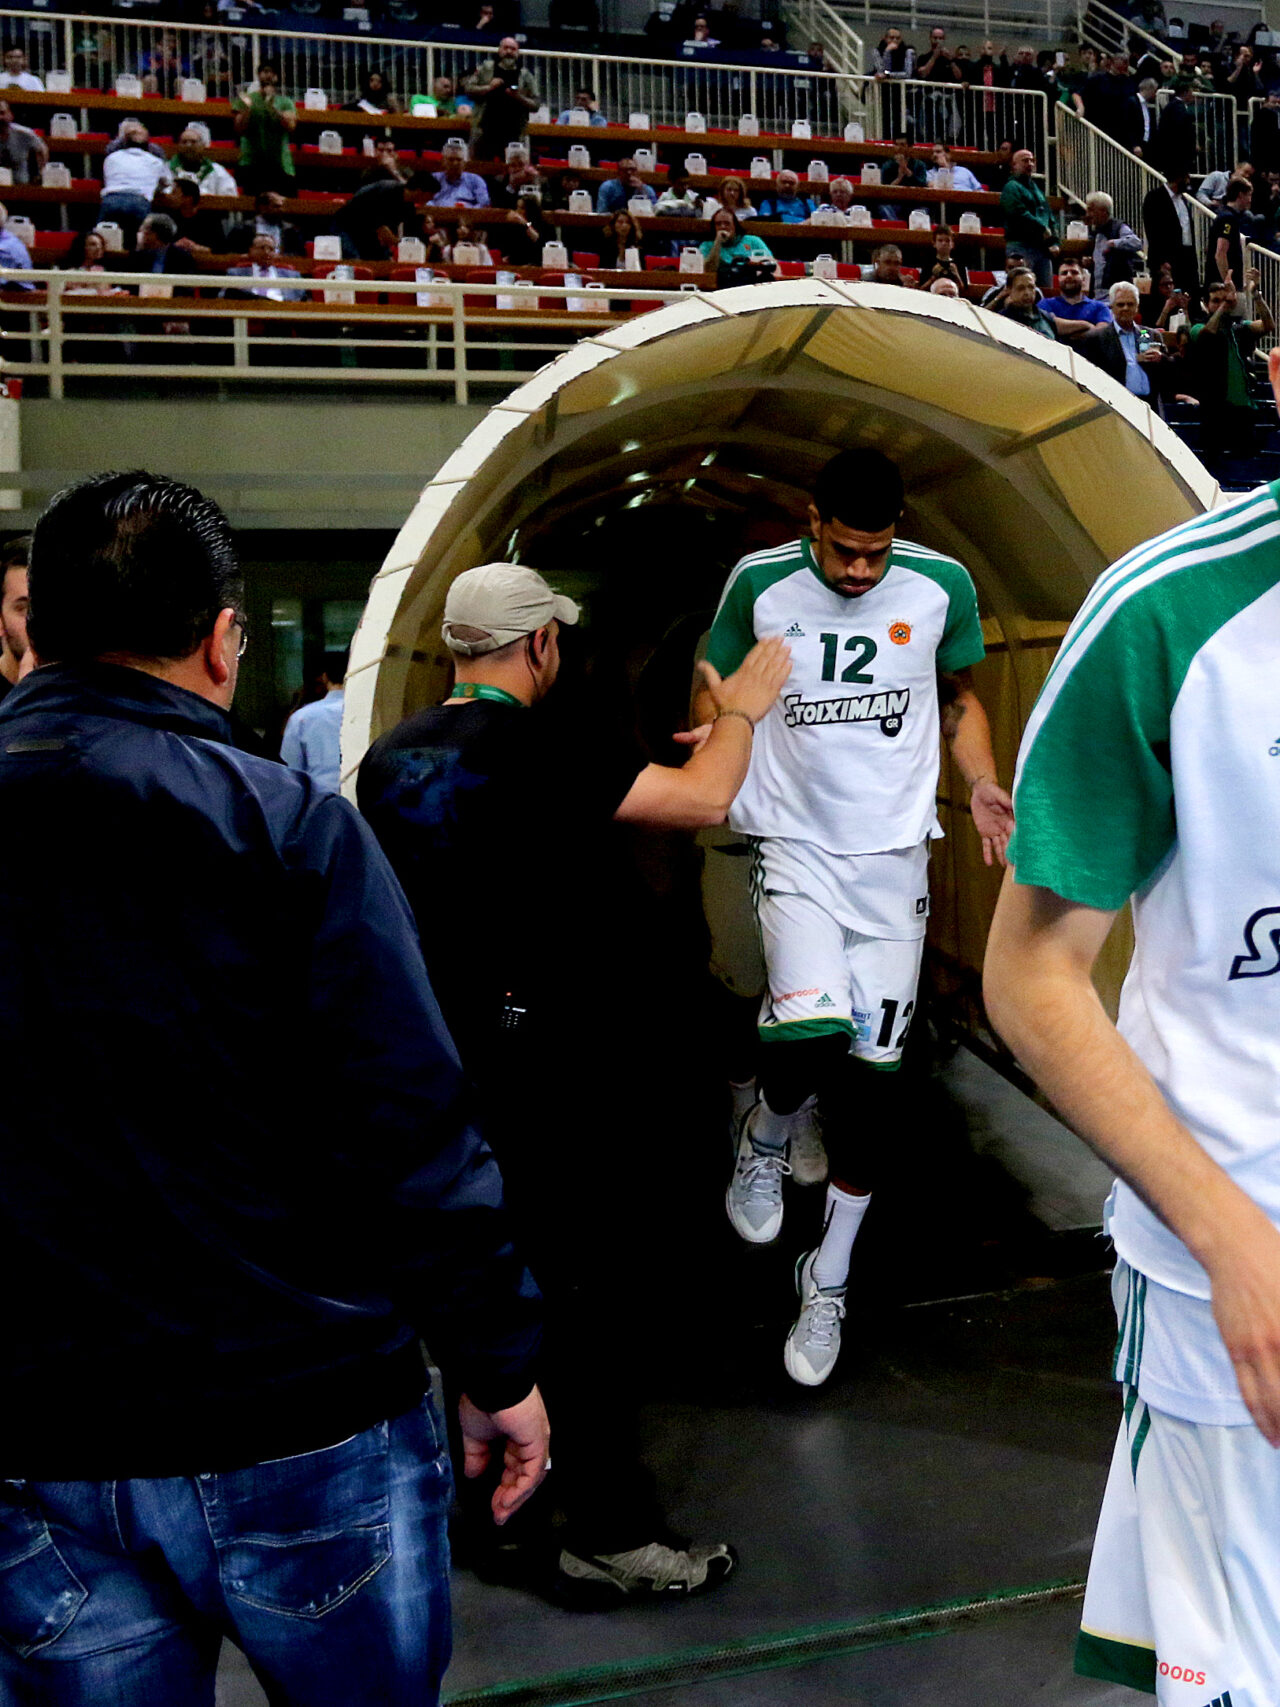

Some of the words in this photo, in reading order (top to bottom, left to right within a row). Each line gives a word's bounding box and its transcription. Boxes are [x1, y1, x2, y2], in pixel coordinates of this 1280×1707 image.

[820, 632, 878, 684] 12
[784, 689, 909, 727] STOIXIMAN
[885, 718, 899, 729] GR
[1157, 1661, 1206, 1685] OODS
